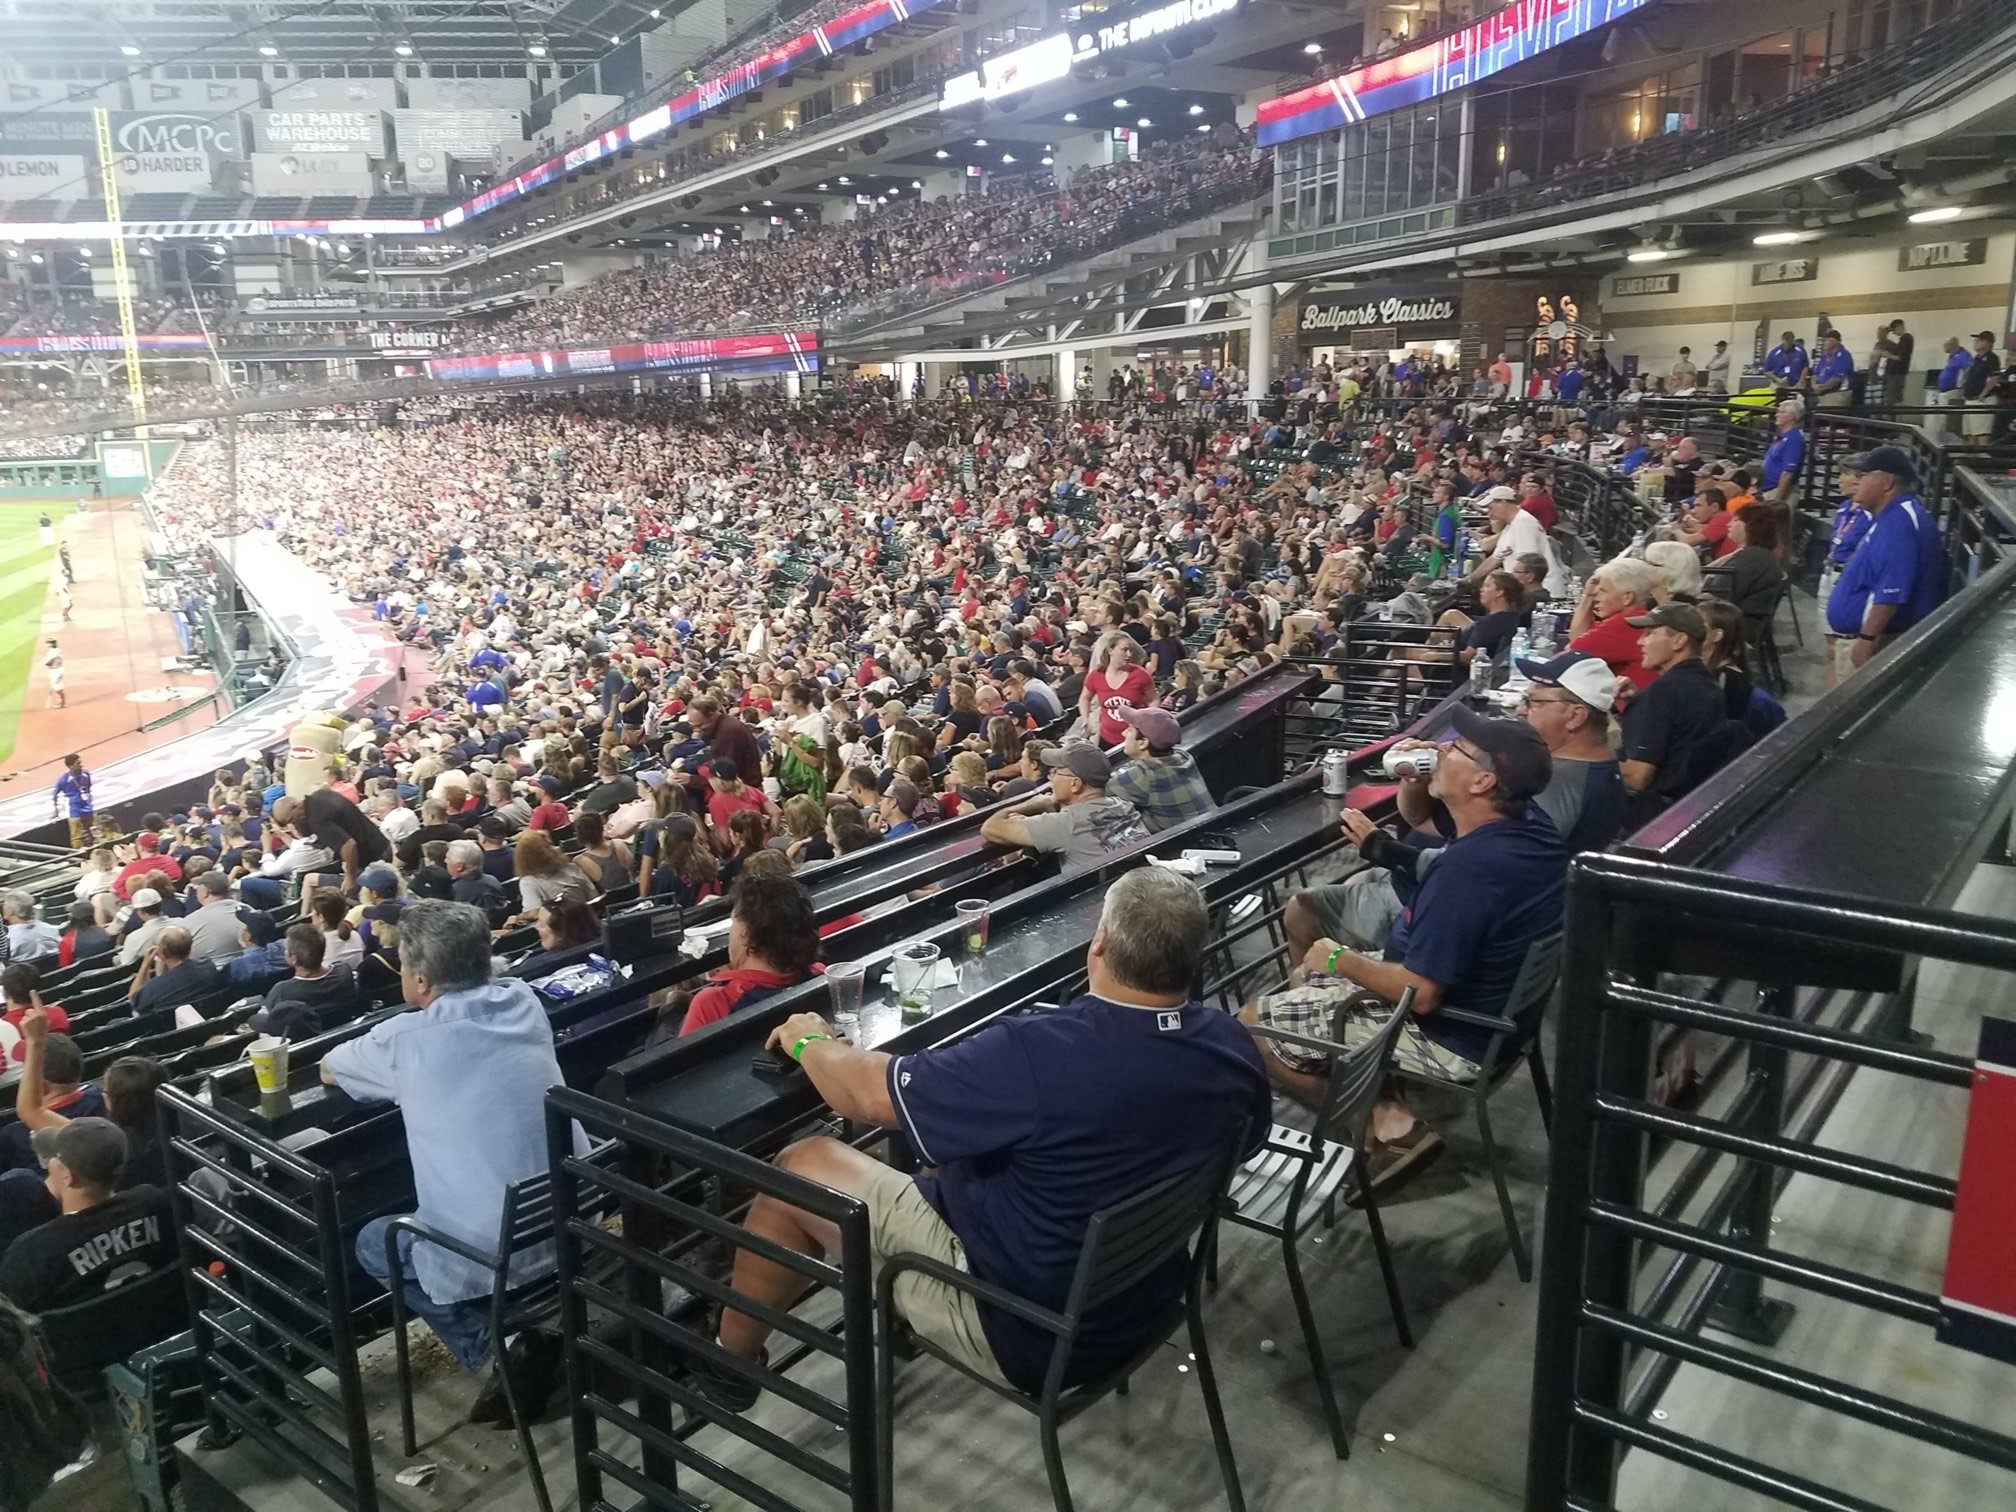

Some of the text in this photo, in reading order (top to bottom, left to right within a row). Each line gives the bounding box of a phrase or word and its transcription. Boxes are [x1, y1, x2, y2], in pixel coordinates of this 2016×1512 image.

[1098, 21, 1129, 51] THE
[269, 113, 365, 126] CAR PARTS
[265, 127, 371, 141] WAREHOUSE
[8, 161, 60, 176] LEMON
[143, 157, 204, 172] HARDER
[1301, 297, 1454, 331] Ballpark Classics
[369, 333, 392, 348] THE
[392, 333, 439, 347] CORNER
[67, 1215, 160, 1276] RIPKEN
